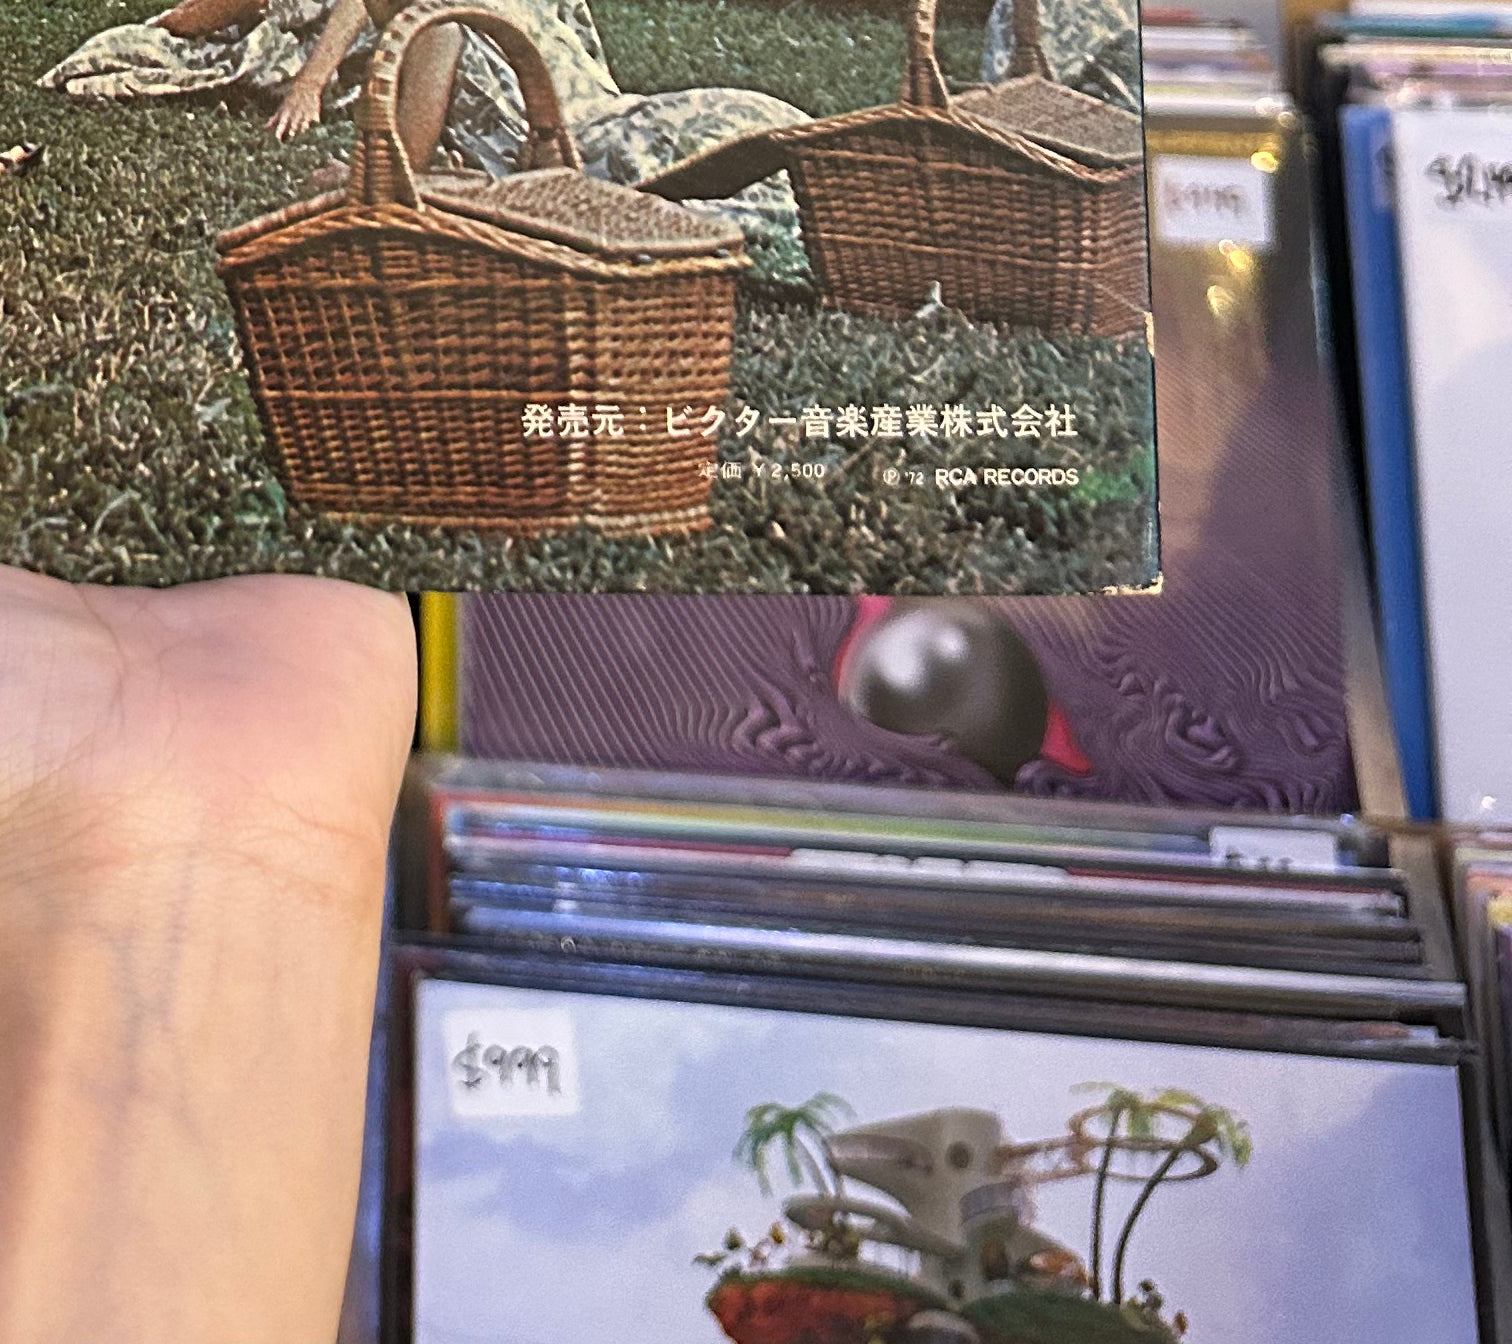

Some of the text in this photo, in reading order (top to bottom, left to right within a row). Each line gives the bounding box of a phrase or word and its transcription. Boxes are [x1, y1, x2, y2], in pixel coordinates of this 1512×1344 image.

[521, 401, 1078, 439] 発売元：ビクター音楽産業株式会社
[935, 468, 976, 486] RCA
[984, 468, 1079, 486] RECORDS
